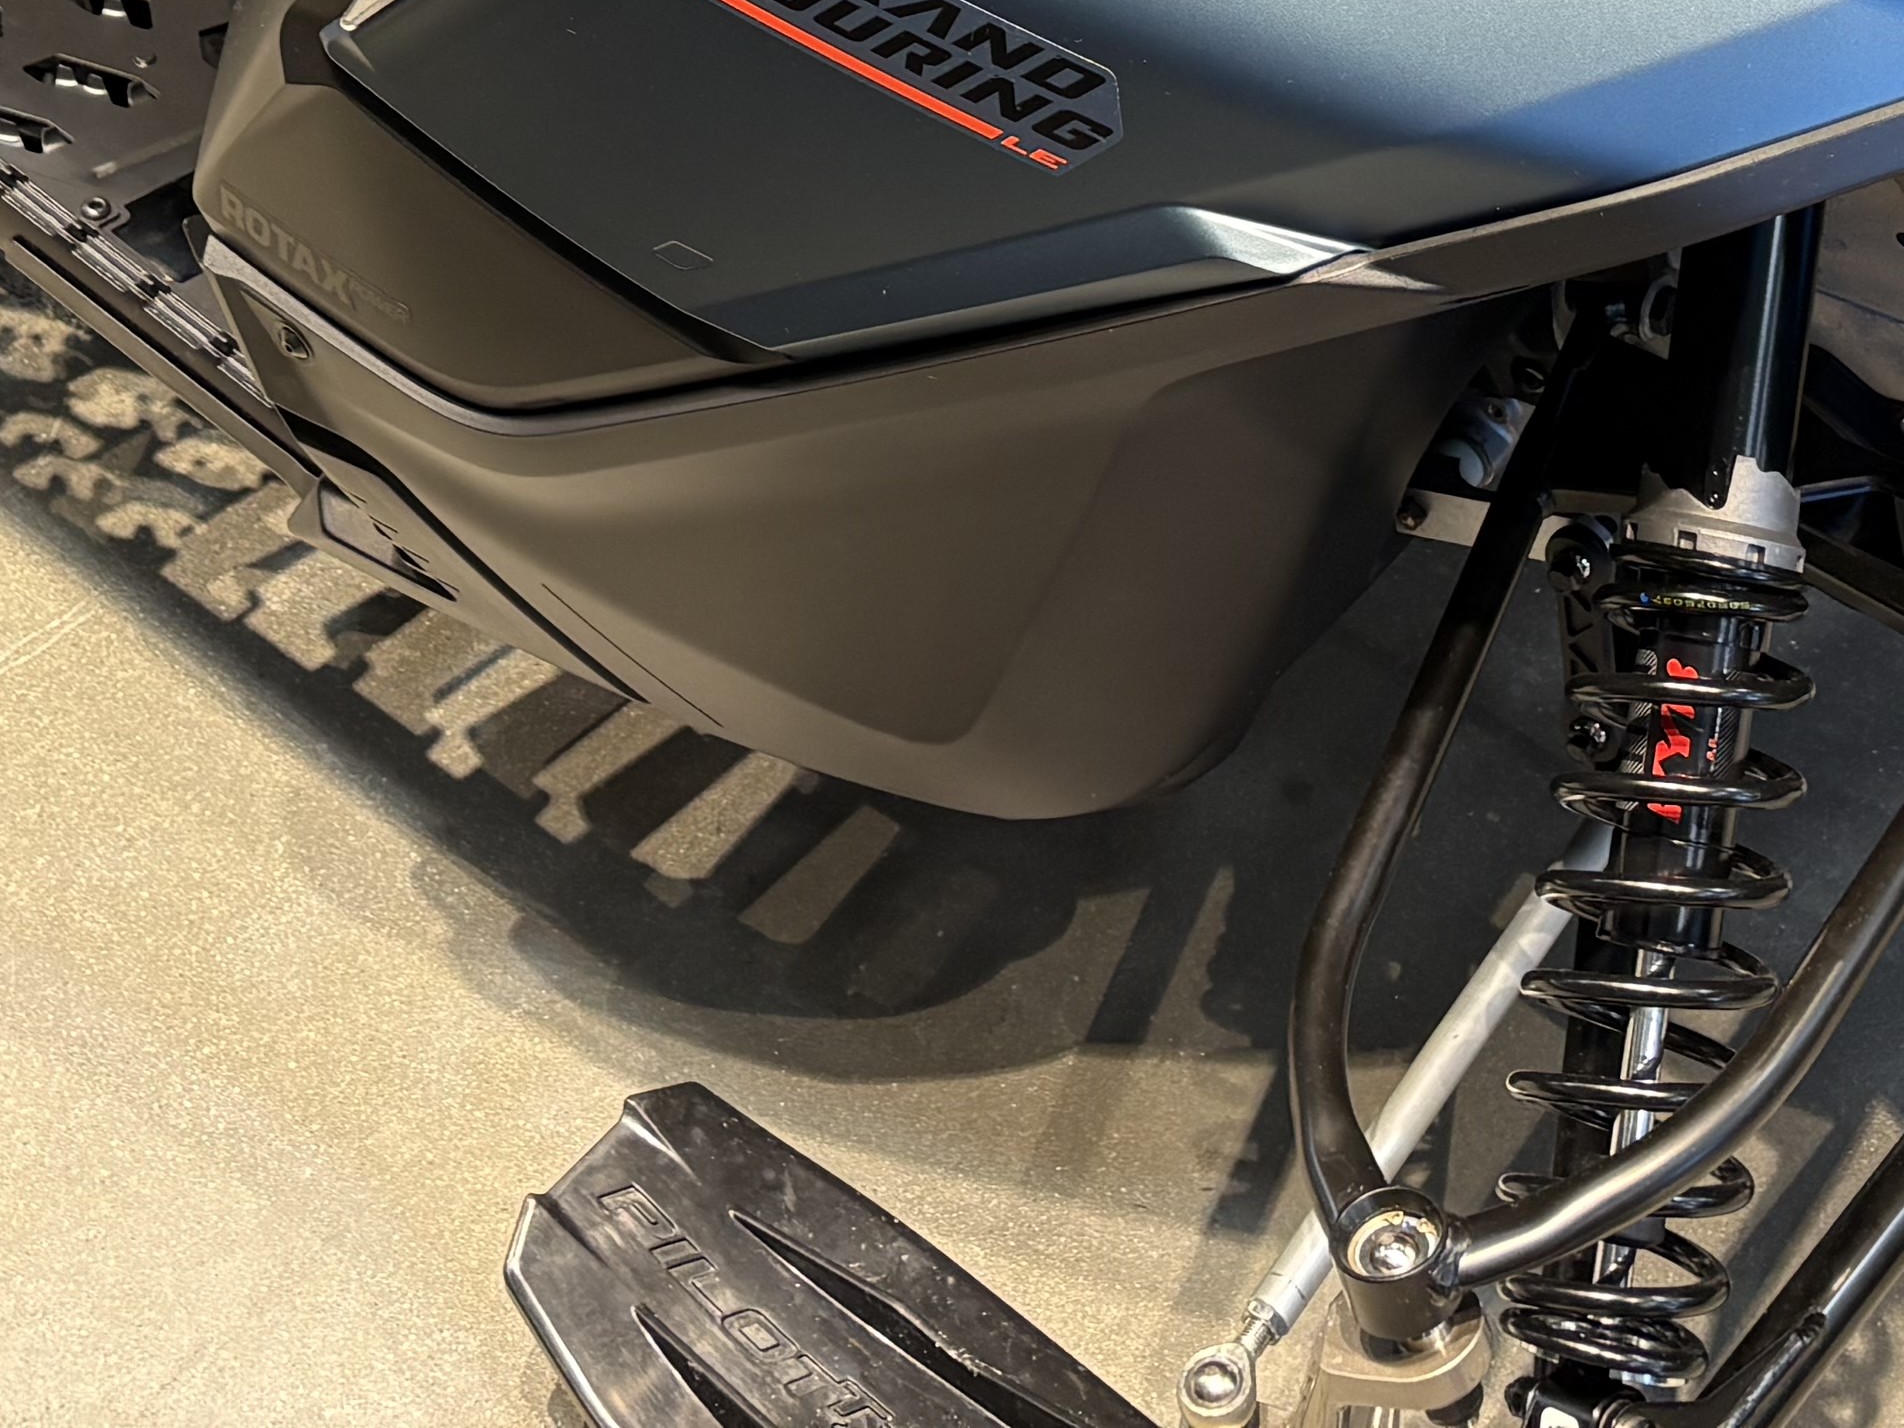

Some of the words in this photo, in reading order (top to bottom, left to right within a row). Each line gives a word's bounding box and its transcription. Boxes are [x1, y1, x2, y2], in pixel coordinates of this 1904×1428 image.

[1000, 135, 1069, 171] LE
[220, 184, 356, 311] ROTAX
[597, 1182, 839, 1404] PILOT
